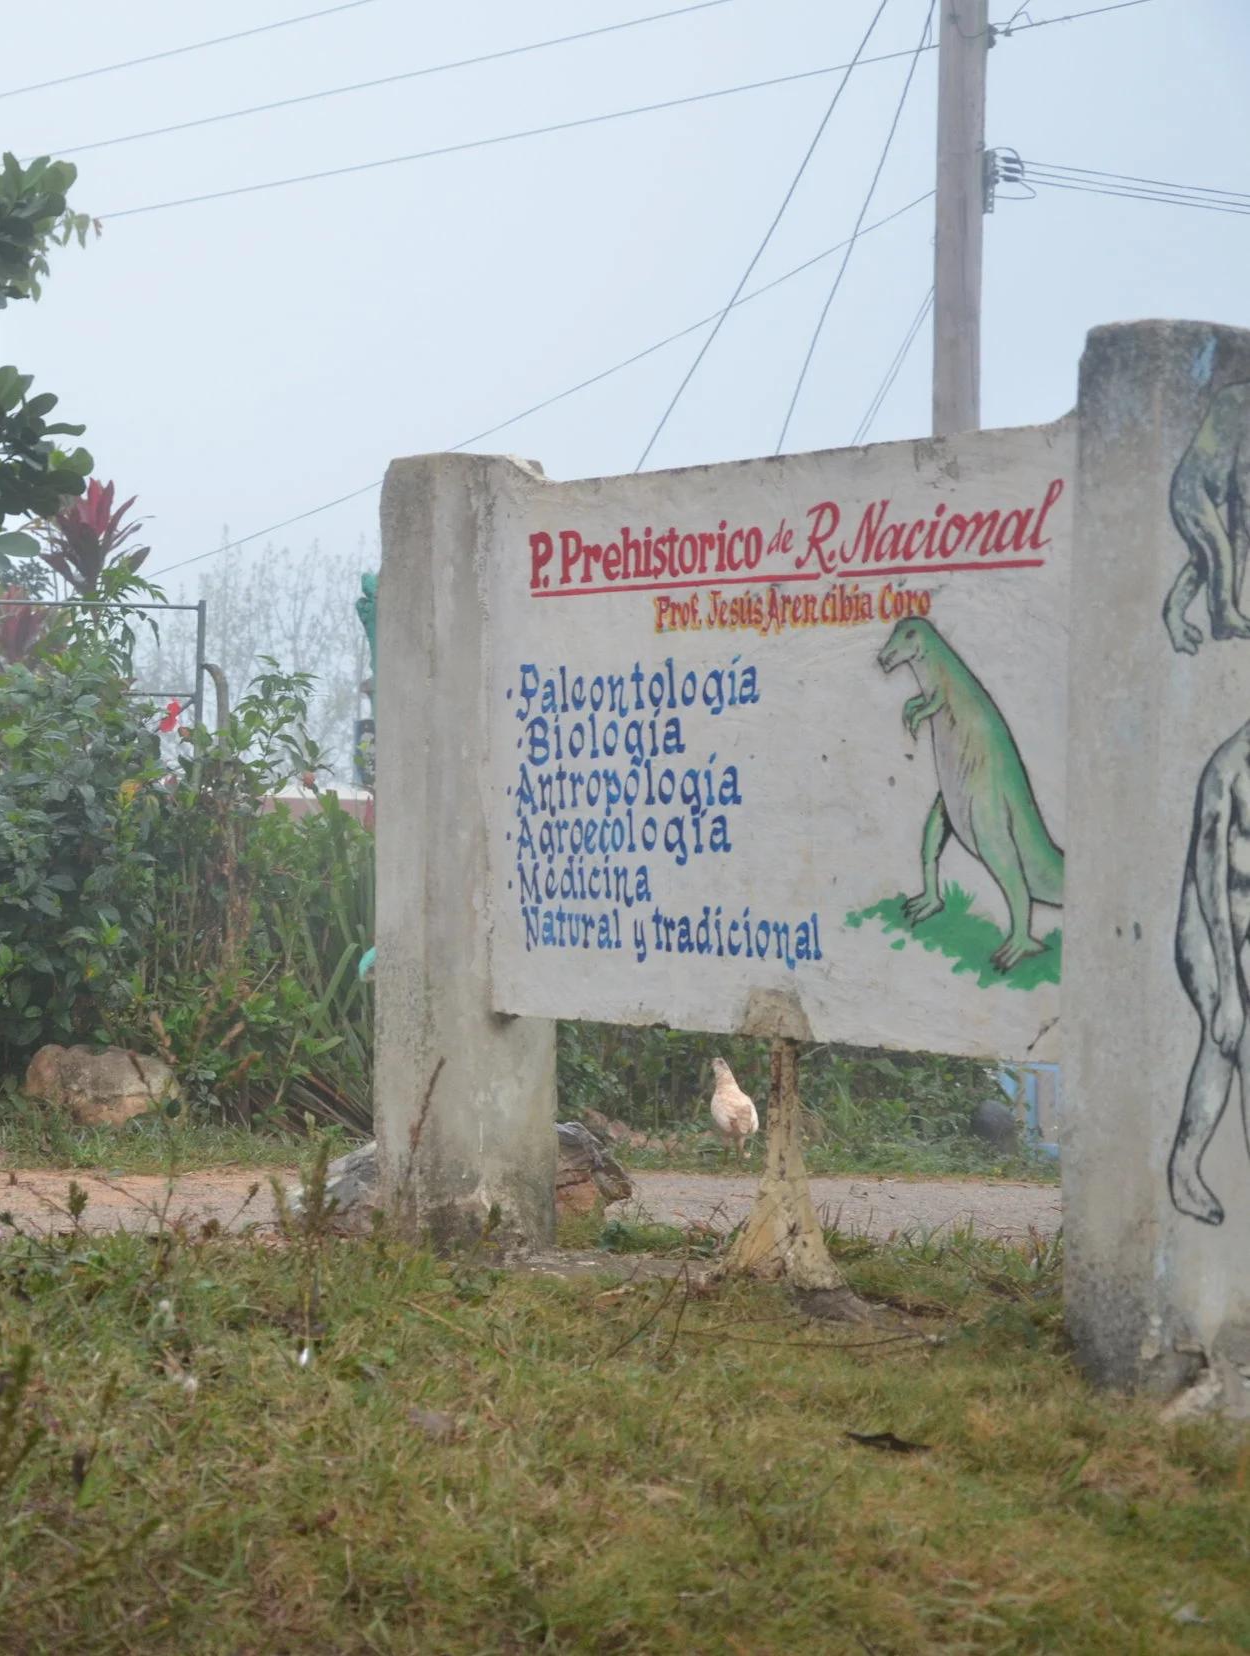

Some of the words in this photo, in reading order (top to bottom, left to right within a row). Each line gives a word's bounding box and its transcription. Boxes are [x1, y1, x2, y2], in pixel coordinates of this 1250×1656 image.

[558, 519, 763, 584] Prehistorico
[767, 518, 794, 556] de
[839, 478, 1064, 564] Nacional
[654, 594, 702, 634] Prof.
[759, 583, 874, 636] Arencibia
[878, 582, 932, 623] Coro
[516, 653, 761, 722] Paleontología
[526, 705, 686, 767] Biología
[515, 752, 742, 817] Antropología
[517, 808, 732, 866] Agroecología
[517, 854, 652, 908] Medicina
[521, 904, 622, 952] Natural
[633, 917, 648, 963] y
[651, 905, 823, 970] tradicional
